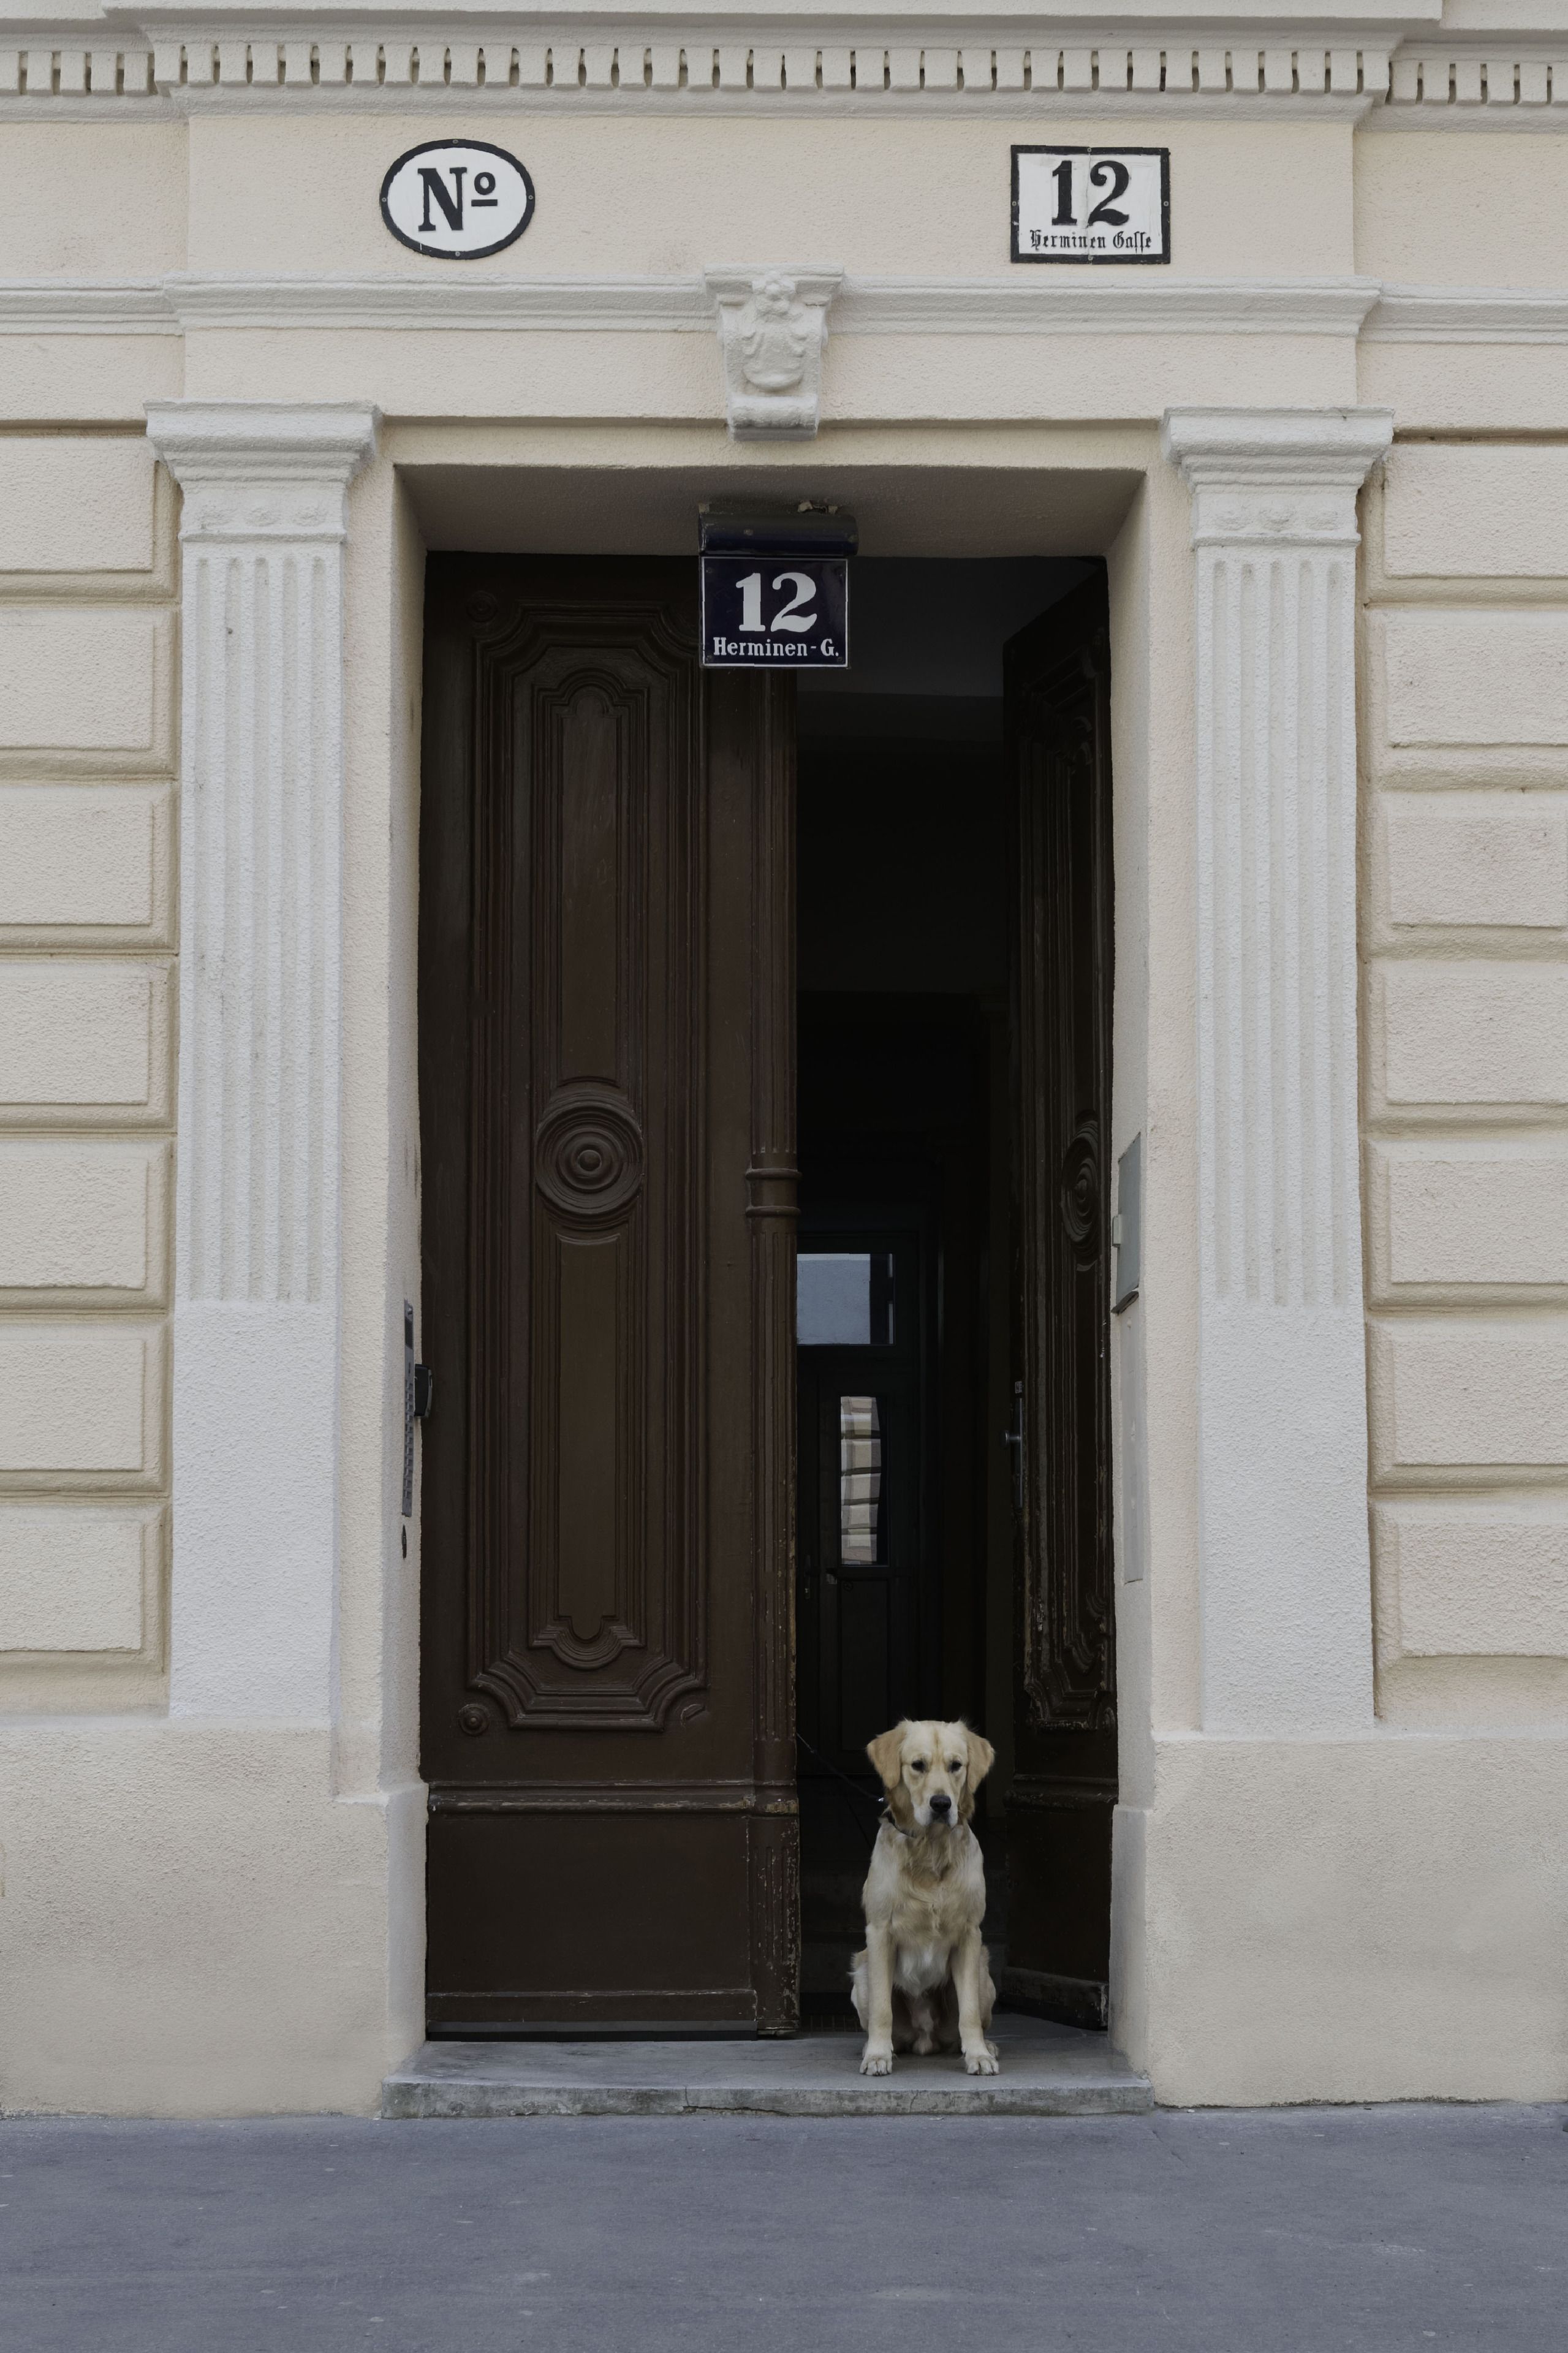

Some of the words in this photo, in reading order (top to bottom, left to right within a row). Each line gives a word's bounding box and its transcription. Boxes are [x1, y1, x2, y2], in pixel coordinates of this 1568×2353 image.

[1051, 160, 1130, 227] 12
[1030, 229, 1107, 251] Herminen
[735, 572, 817, 633] 12
